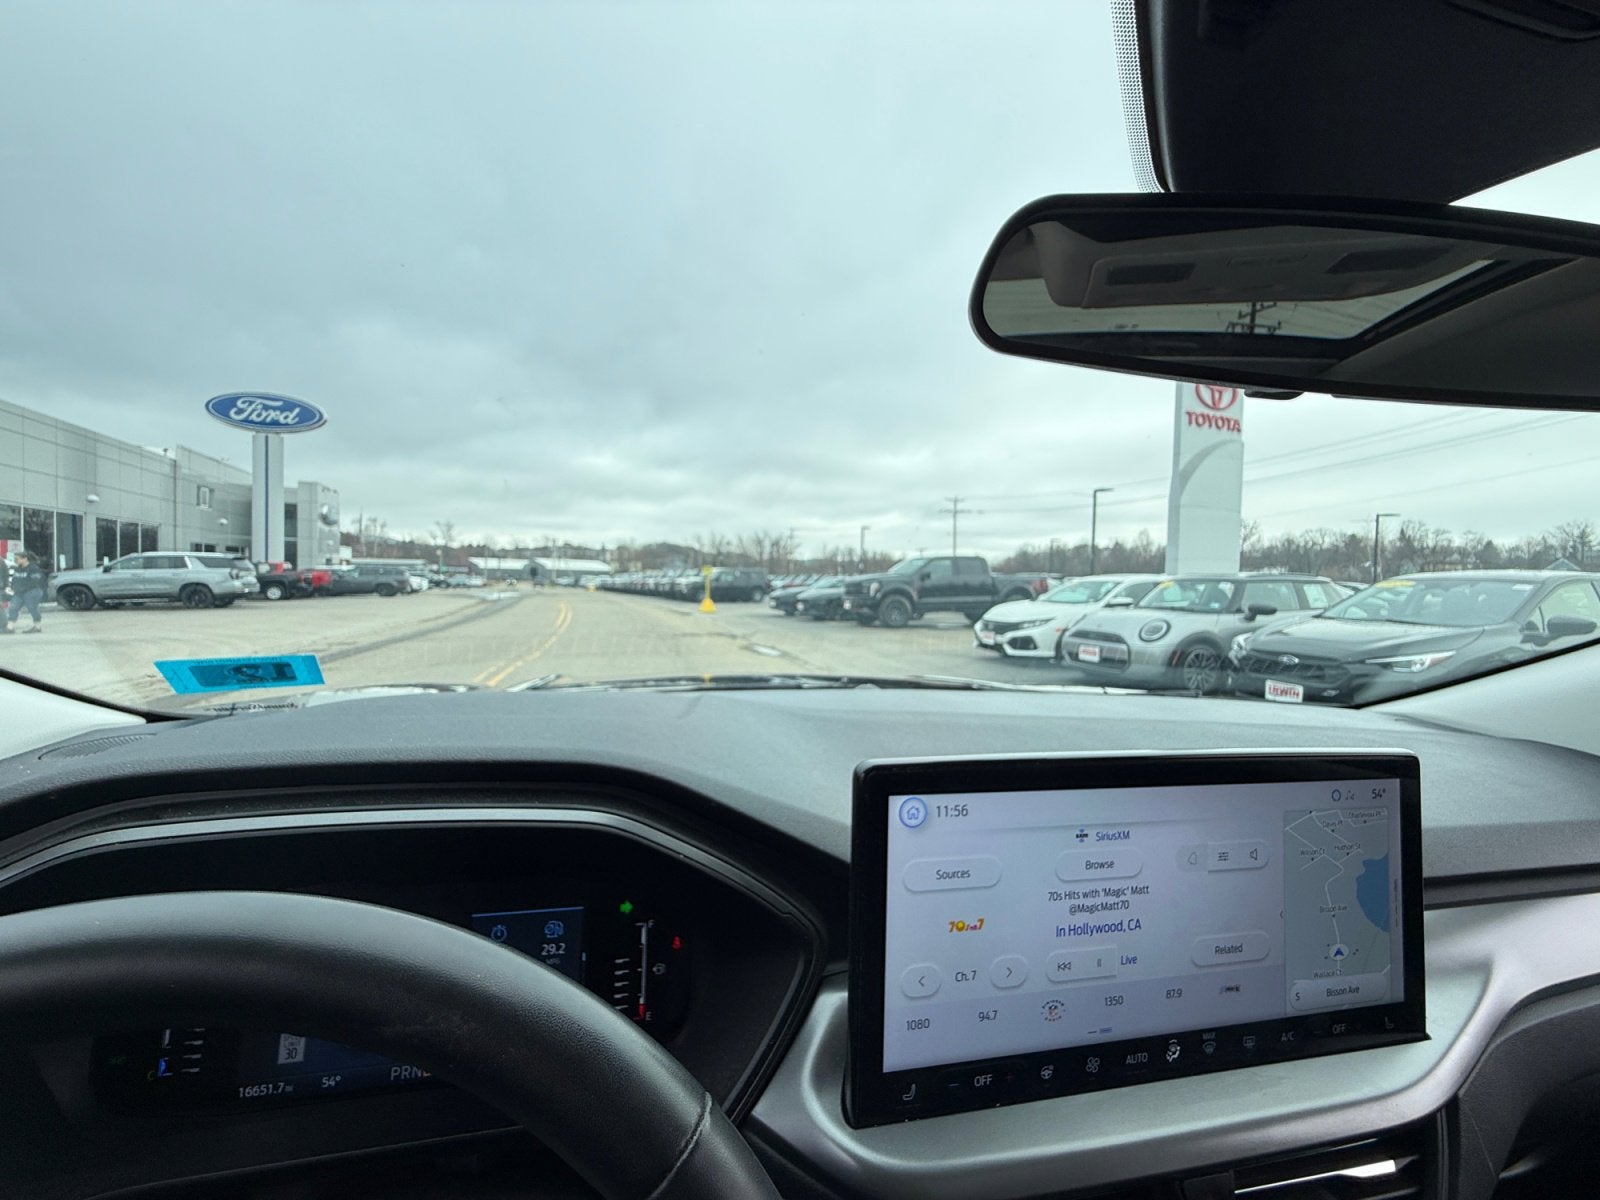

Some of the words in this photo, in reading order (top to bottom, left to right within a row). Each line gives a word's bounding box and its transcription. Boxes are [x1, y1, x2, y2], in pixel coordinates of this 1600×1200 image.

[229, 397, 300, 424] Ford
[1185, 411, 1242, 432] TOYOTA
[936, 803, 969, 818] 11:56
[1095, 830, 1131, 842] SiriusXM
[1085, 860, 1115, 871] Browse
[935, 869, 971, 881] Sources
[1048, 891, 1063, 902] 70s
[1064, 890, 1081, 901] Hits
[1082, 889, 1100, 899] with
[1131, 885, 1150, 896] Matt
[1068, 899, 1130, 916] @MagicMatt70
[1055, 925, 1066, 938] In
[1067, 920, 1126, 937] Hollywood,
[1127, 918, 1142, 932] CA
[541, 943, 566, 956] 29.2
[1214, 943, 1244, 955] Related
[1120, 955, 1138, 966] Live
[1165, 988, 1183, 999] 87.9
[1295, 992, 1301, 1001] S
[1326, 987, 1347, 998] Bisson
[1347, 985, 1360, 995] Ave
[1104, 995, 1124, 1007] 1350
[978, 1010, 998, 1022] 94.7
[906, 1018, 931, 1031] 1080
[1332, 1023, 1347, 1034] OFF
[1281, 1031, 1296, 1042] A/C
[285, 1047, 298, 1060] 30
[1126, 1053, 1149, 1065] AUTO
[321, 1075, 342, 1088] 54°
[974, 1074, 993, 1087] OFF
[238, 1082, 285, 1098] 16651.7
